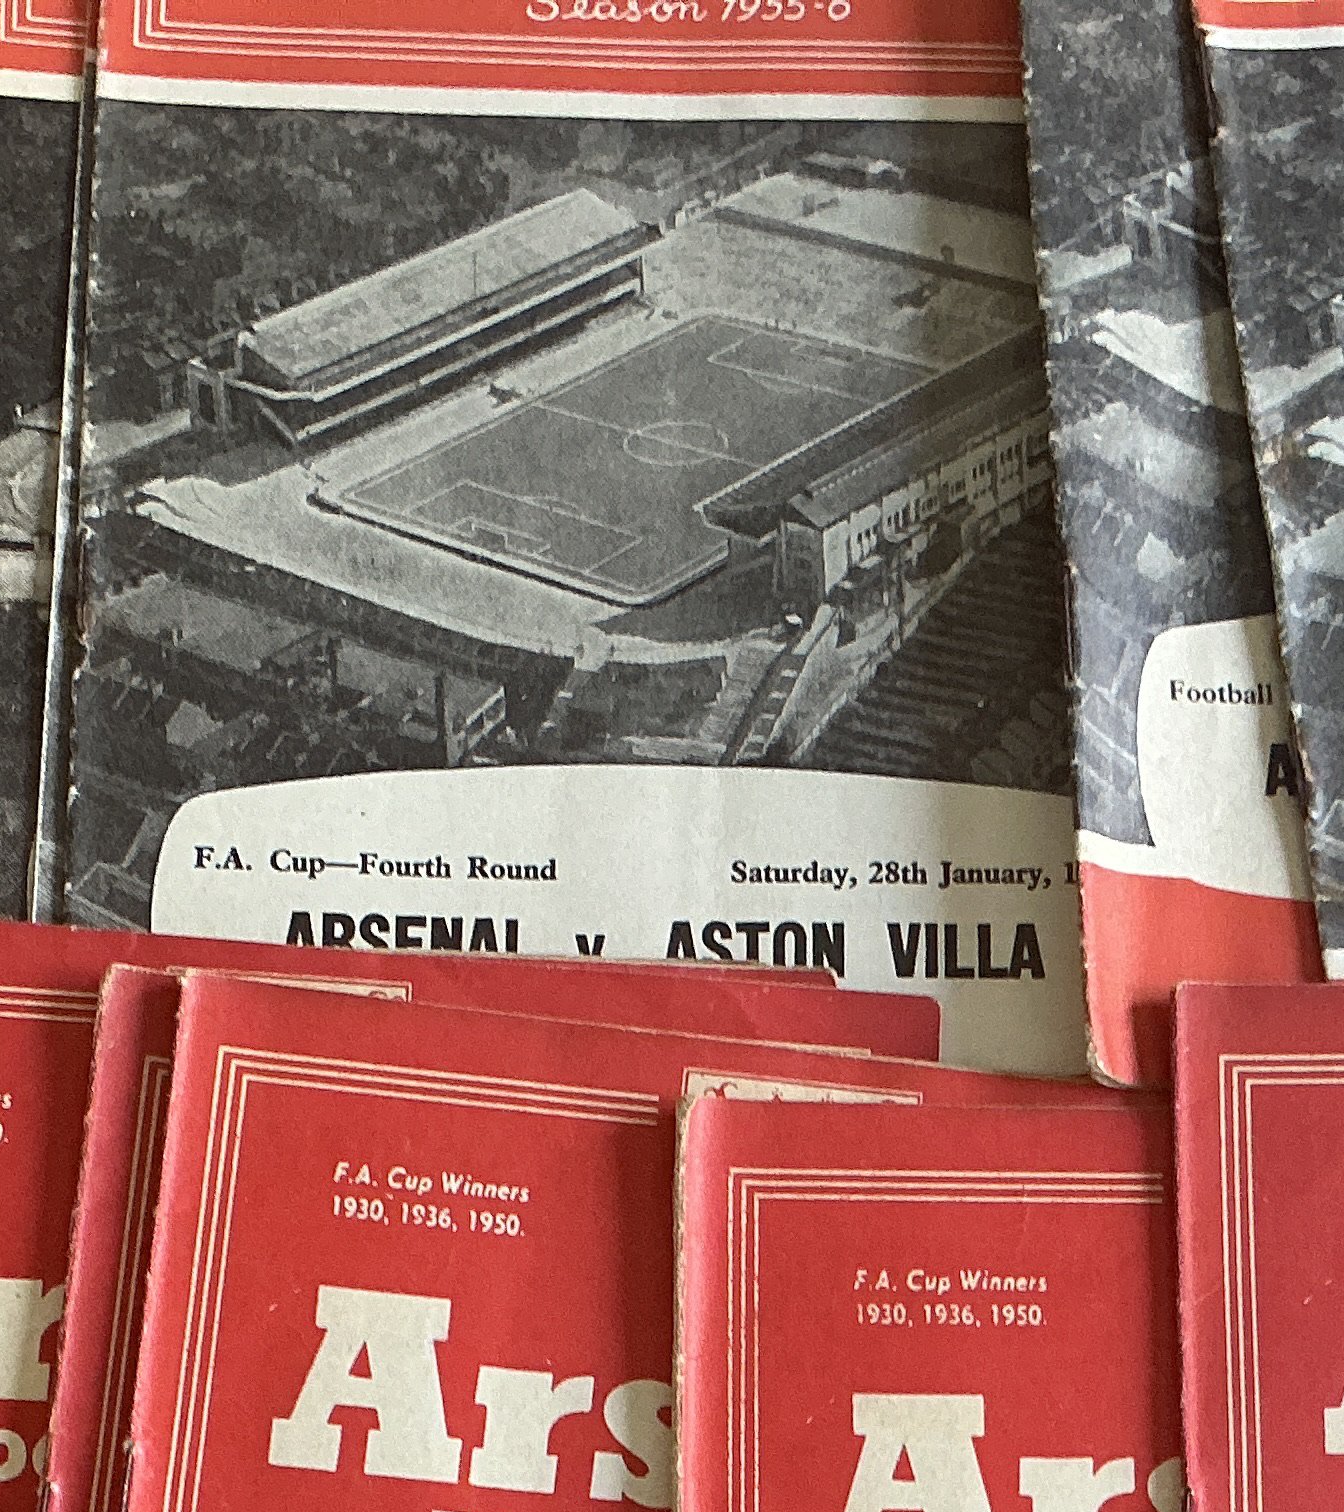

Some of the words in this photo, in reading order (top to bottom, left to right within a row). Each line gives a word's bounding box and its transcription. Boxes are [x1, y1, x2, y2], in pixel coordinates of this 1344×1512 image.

[1169, 679, 1274, 706] Football
[194, 846, 254, 872] F.A.
[467, 855, 558, 882] Round
[729, 859, 857, 891] Saturday,
[868, 860, 928, 886] 28th
[938, 860, 1052, 891] January,
[665, 920, 846, 979] ASTON
[886, 921, 1047, 980] VILLA
[332, 1160, 379, 1187] F.A.
[387, 1165, 434, 1195] Cup
[441, 1170, 531, 1204] Winners
[331, 1195, 389, 1226] 1930,
[400, 1201, 458, 1233] 1936,
[468, 1208, 526, 1238] 1950.
[853, 1269, 897, 1293] F.A.
[906, 1269, 951, 1295] Cup
[959, 1269, 1049, 1293] Winners
[856, 1303, 914, 1328] 1930,
[923, 1303, 982, 1328] 1936,
